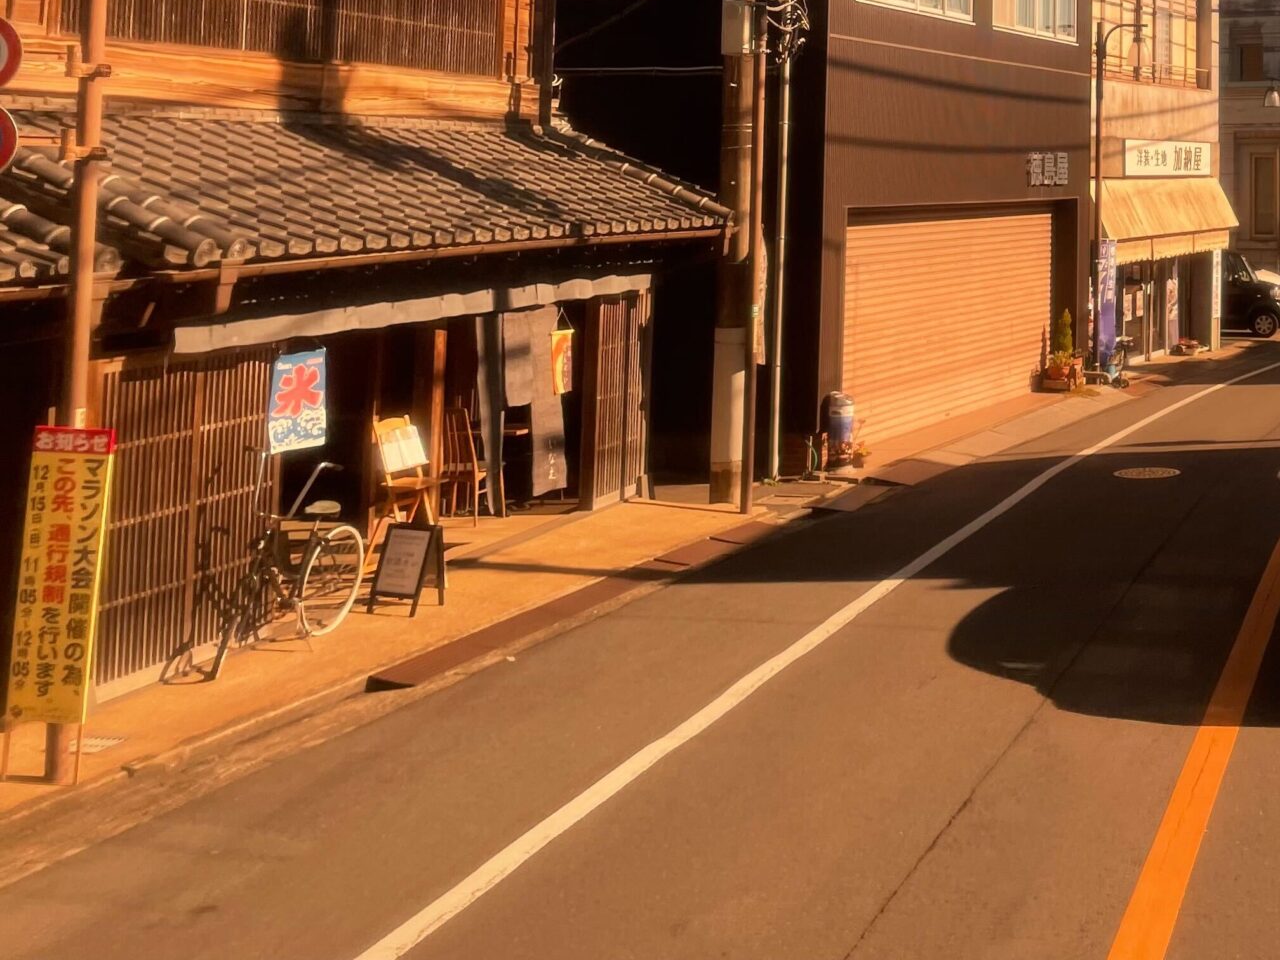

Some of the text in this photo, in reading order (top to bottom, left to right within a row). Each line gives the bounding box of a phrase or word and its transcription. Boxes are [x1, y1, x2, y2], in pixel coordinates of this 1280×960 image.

[1173, 145, 1202, 172] 加納屋
[270, 363, 323, 418] 氷
[35, 432, 109, 452] お知らせ
